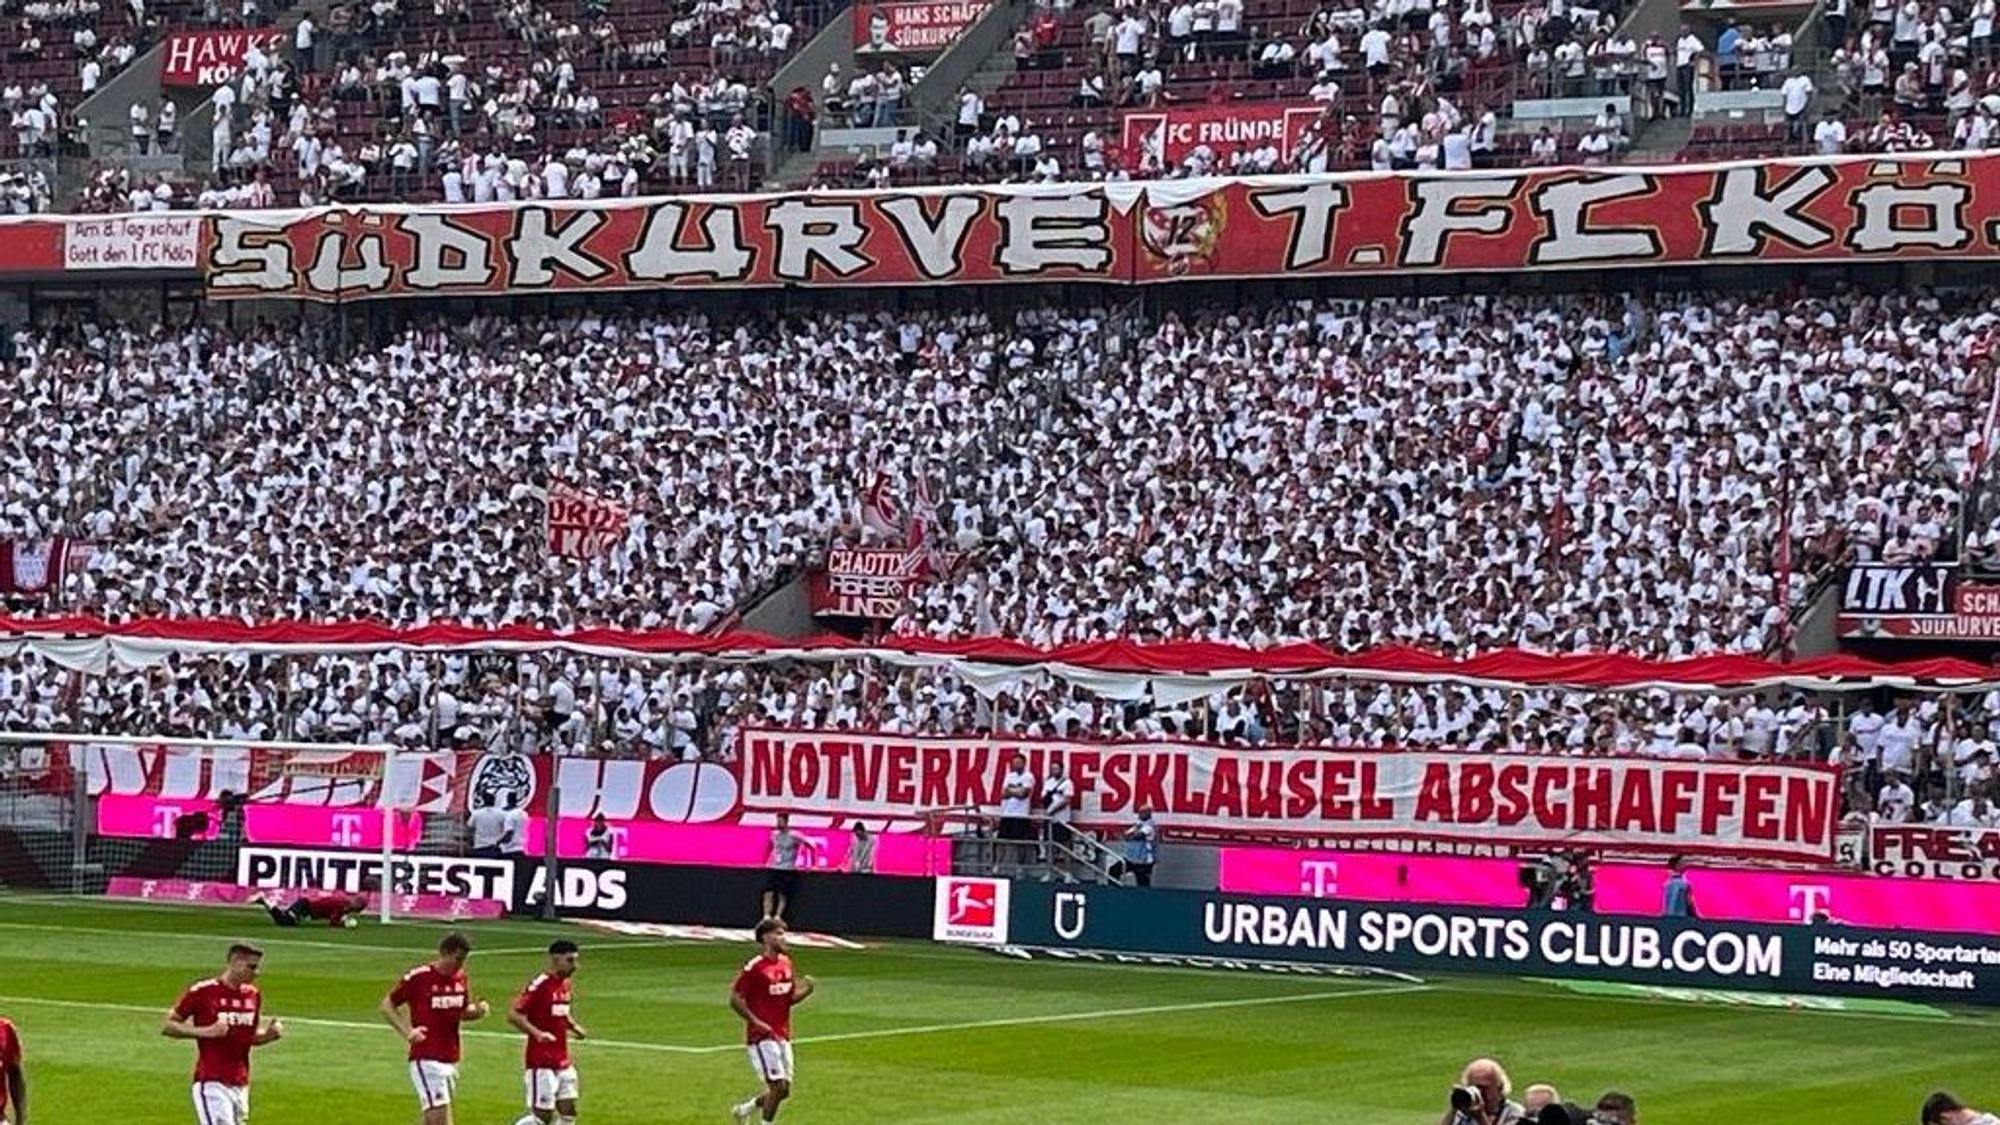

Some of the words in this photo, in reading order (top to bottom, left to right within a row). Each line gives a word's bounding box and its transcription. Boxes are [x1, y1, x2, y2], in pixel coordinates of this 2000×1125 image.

[894, 7, 931, 25] HANS
[1167, 123, 1193, 145] FC
[1199, 117, 1283, 143] FRÜNDE
[205, 193, 1112, 292] SÜDKURVE
[1167, 214, 1197, 246] 12
[68, 244, 98, 263] Gott
[102, 245, 127, 263] den
[162, 243, 194, 263] Köln
[828, 550, 907, 576] CHAOTIX
[1844, 568, 1915, 610] LTK
[1962, 593, 2000, 613] SCH
[751, 738, 1394, 821] NOTVERKAUFSKLAUSEL
[1414, 762, 1834, 846] ABSCHAFFEN
[249, 854, 504, 900] PINTEREST
[526, 866, 628, 909] ADS
[1204, 902, 1347, 949] URBAN
[1359, 910, 1529, 961] SPORTS
[1540, 922, 1782, 977] CLUB.COM
[1814, 937, 1859, 956] Mehr
[1861, 940, 1886, 958] als
[1889, 941, 1911, 959] 50
[1813, 962, 1851, 981] Eine
[1854, 964, 1975, 989] Mitgliedschaft
